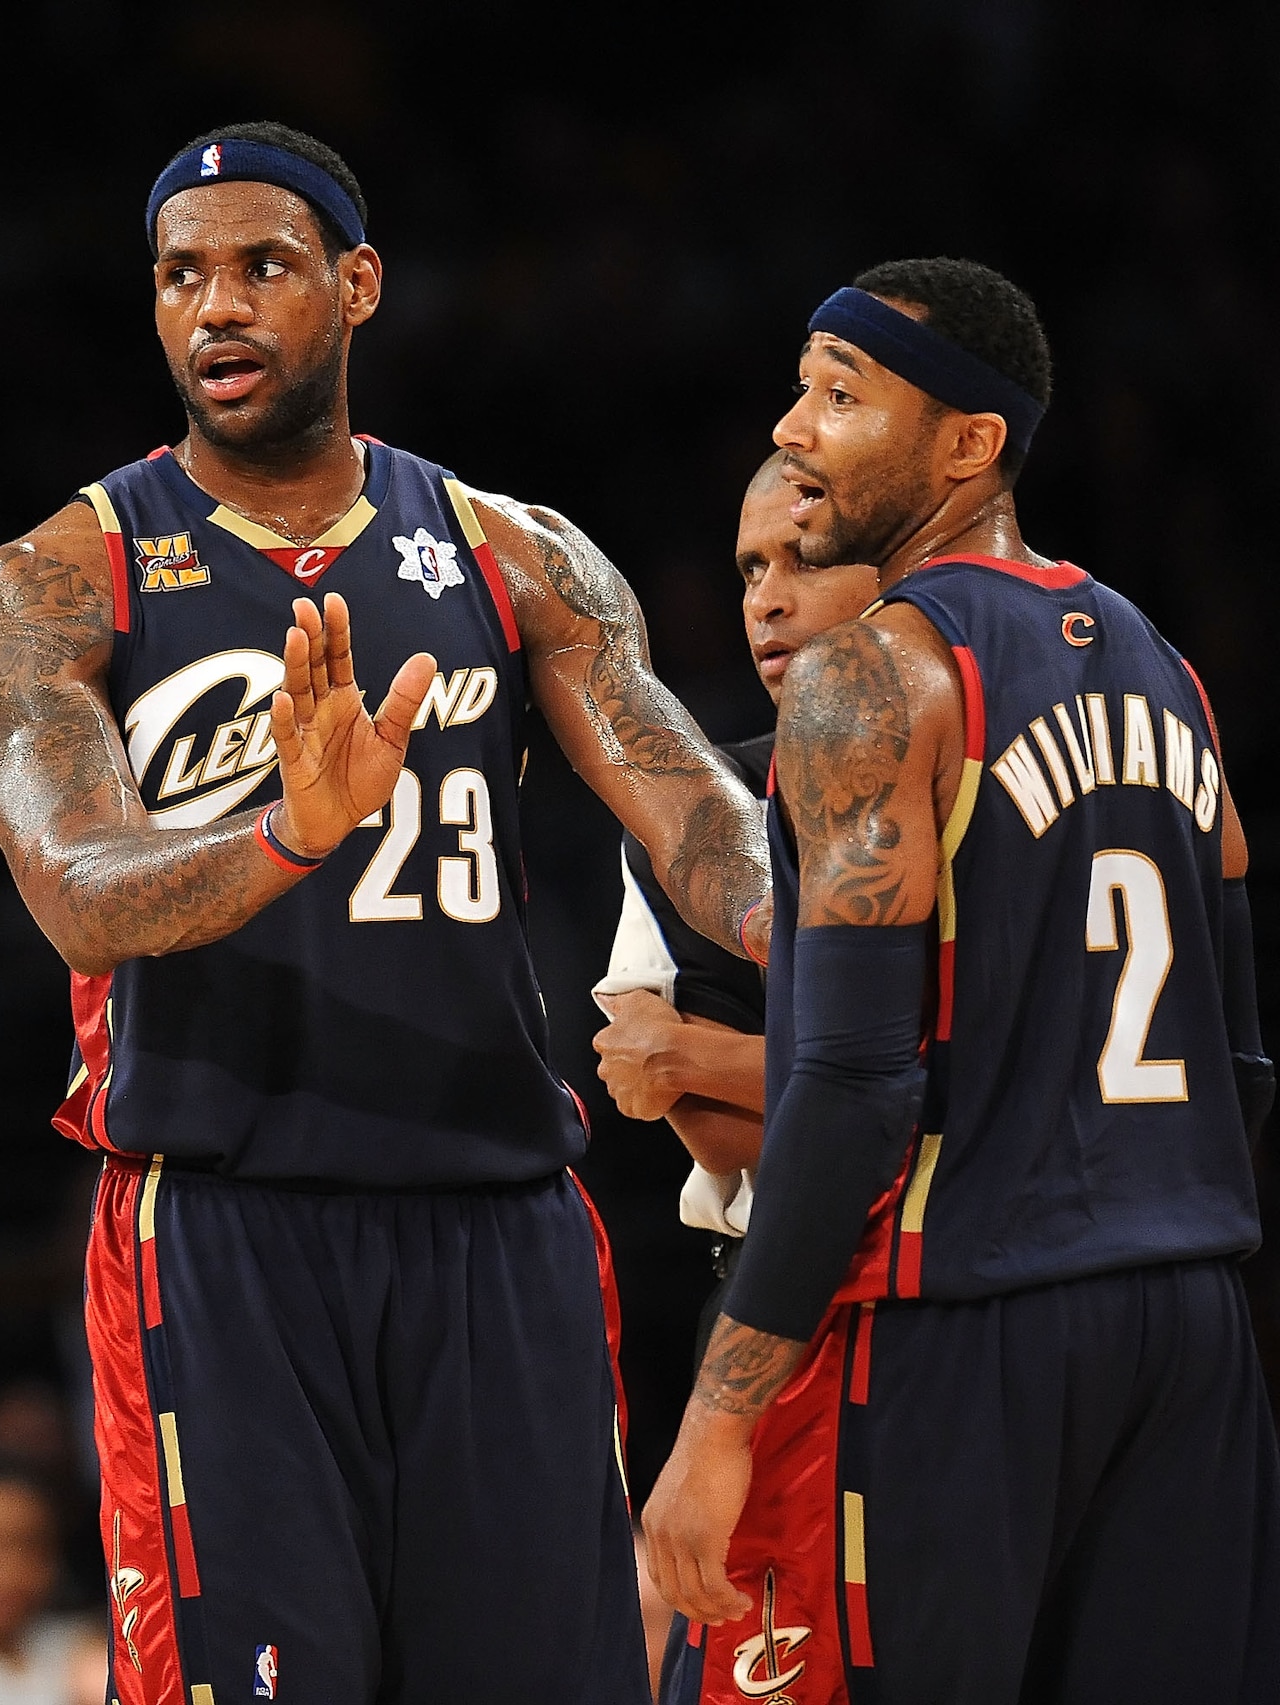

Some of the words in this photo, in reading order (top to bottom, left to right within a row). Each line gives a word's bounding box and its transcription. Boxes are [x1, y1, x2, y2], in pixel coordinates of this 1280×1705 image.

[134, 532, 210, 591] XL
[294, 548, 326, 578] C
[1061, 612, 1095, 647] C
[124, 648, 499, 831] CLEVND
[348, 767, 501, 924] 23
[1086, 848, 1189, 1103] 2
